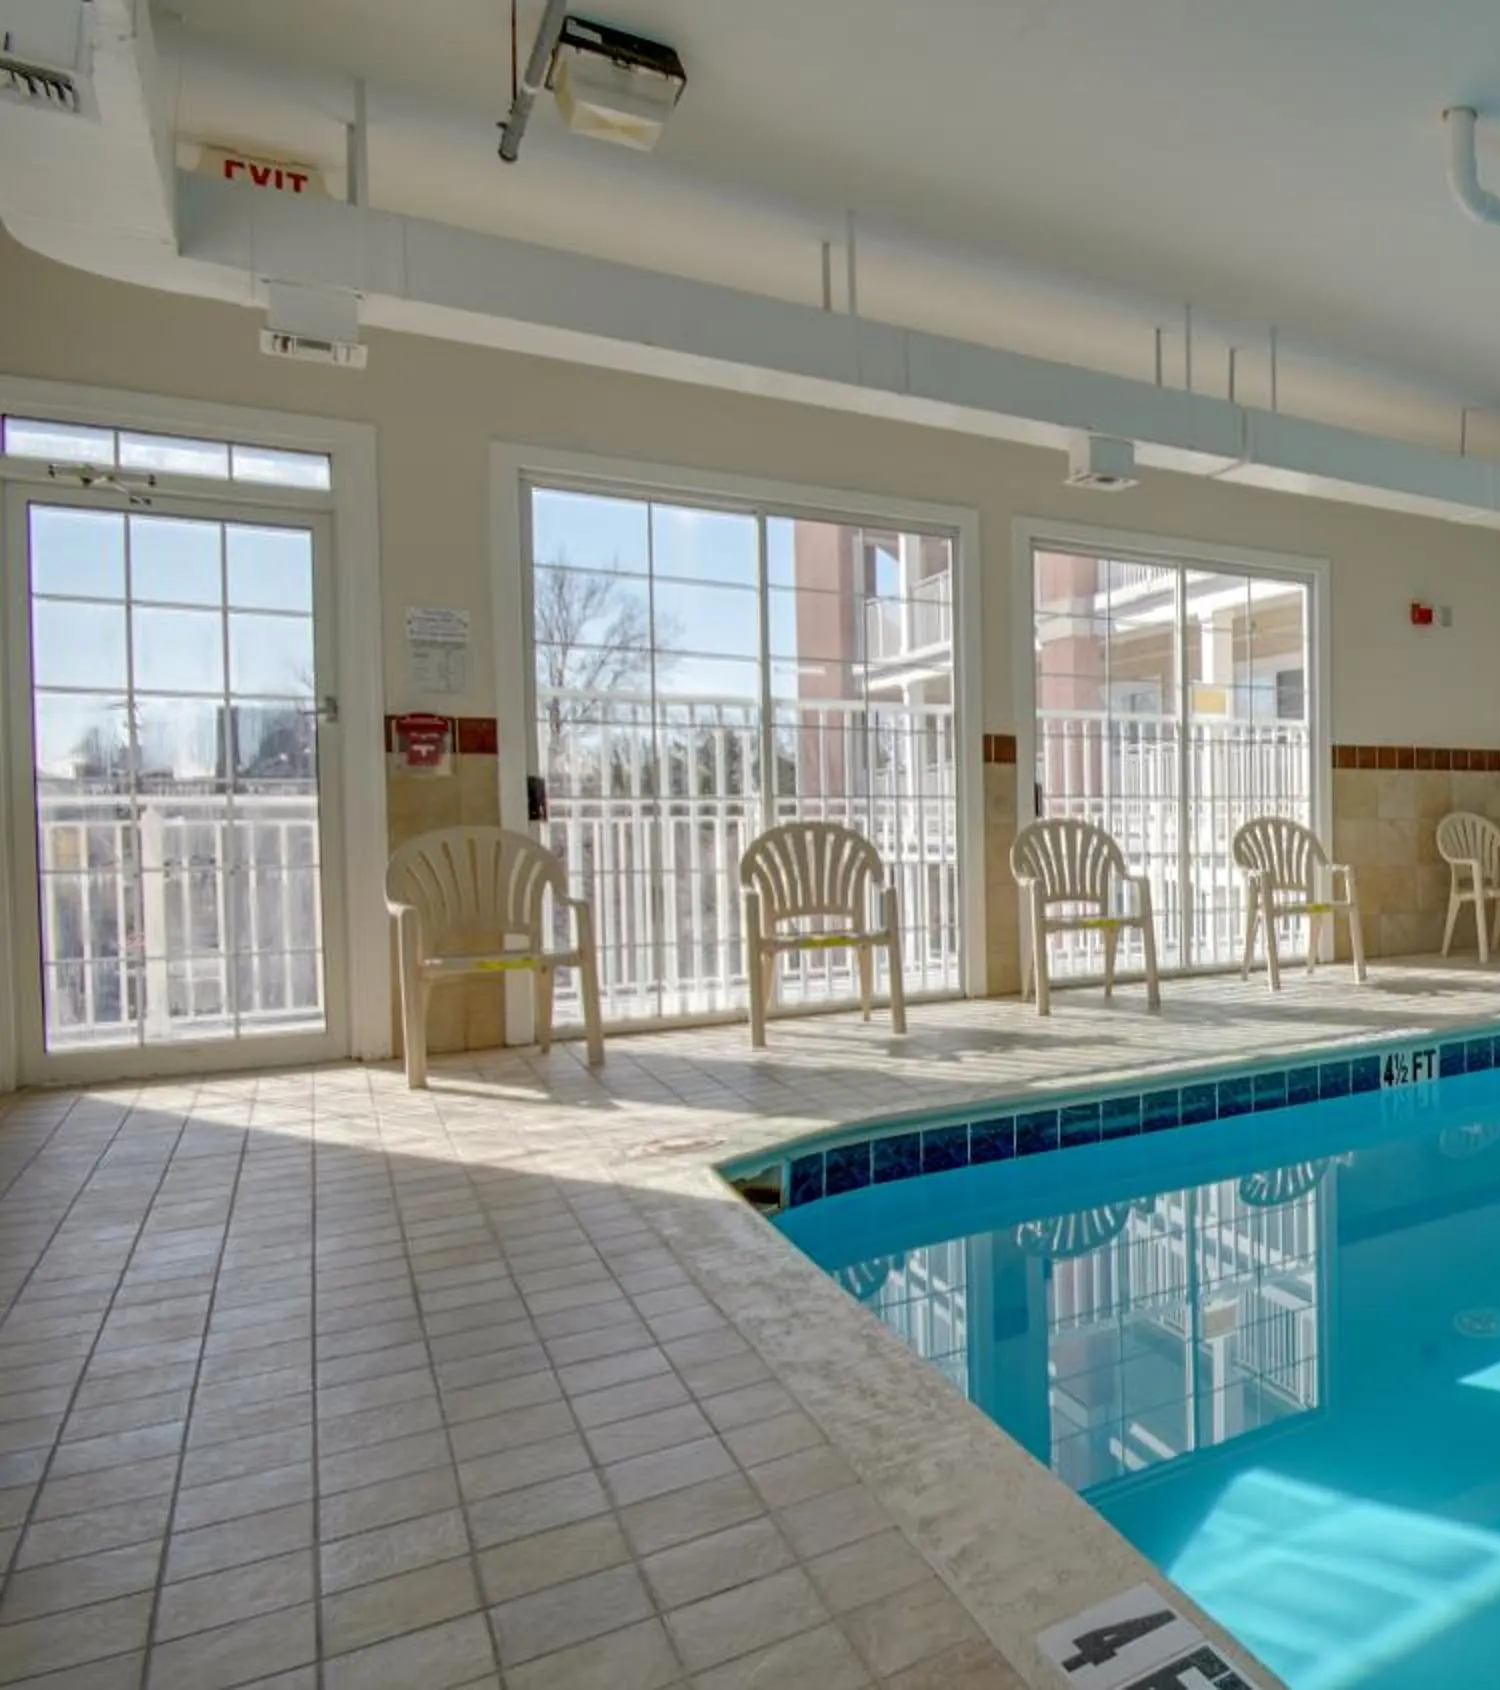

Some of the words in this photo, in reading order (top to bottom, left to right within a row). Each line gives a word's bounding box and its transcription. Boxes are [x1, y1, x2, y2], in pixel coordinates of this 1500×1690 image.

[1412, 1048, 1437, 1082] FT
[1062, 1609, 1177, 1673] 4
[1123, 1646, 1253, 1690] F
